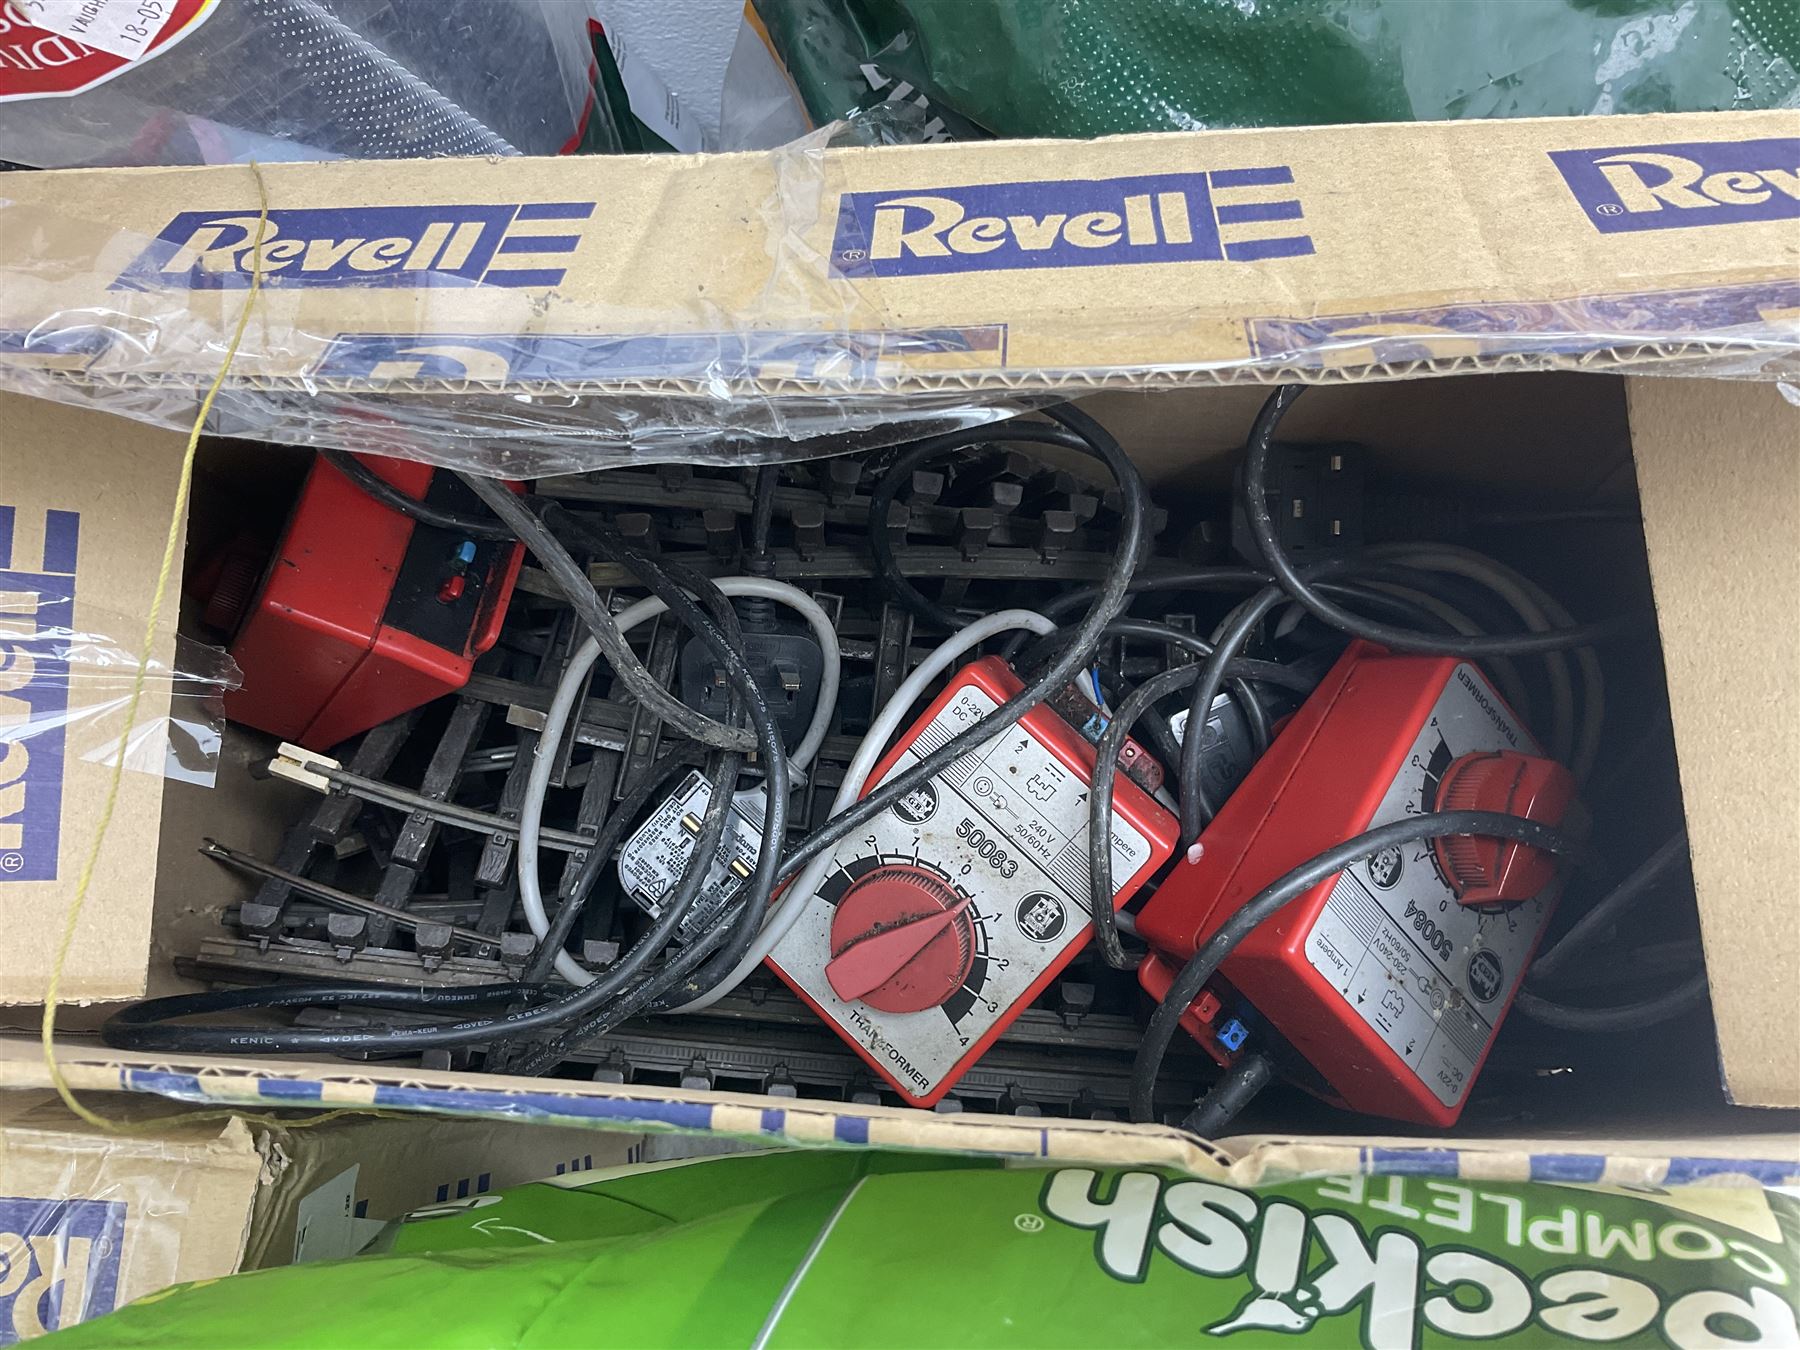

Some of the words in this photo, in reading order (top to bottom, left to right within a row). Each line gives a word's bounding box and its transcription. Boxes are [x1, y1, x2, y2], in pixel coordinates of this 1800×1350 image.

[869, 191, 1192, 259] Revell
[160, 217, 486, 273] Revell
[952, 706, 968, 721] DC
[1457, 669, 1518, 747] TRANSFORMER
[1430, 716, 1438, 727] 4
[1014, 745, 1024, 755] 2
[1411, 754, 1420, 767] 3
[1405, 800, 1415, 813] 2
[1029, 820, 1047, 837] 240
[1046, 835, 1057, 844] V
[864, 834, 878, 847] 2
[911, 836, 921, 847] 1
[956, 818, 1018, 878] 50083
[1014, 825, 1052, 860] 50/60Hz
[1110, 833, 1136, 858] mpere
[960, 863, 972, 876] 0
[1439, 899, 1448, 912] 0
[993, 912, 1003, 923] 1
[1404, 898, 1453, 962] 50084
[1382, 927, 1411, 962] 50/60Hz
[1316, 938, 1344, 970] Ampere
[997, 958, 1010, 972] 2
[987, 1001, 999, 1014] 3
[230, 1036, 274, 1045] KENIC
[507, 1006, 549, 1021] CEBEC
[959, 1036, 971, 1047] 4
[1317, 1176, 1788, 1286] COMPLETE
